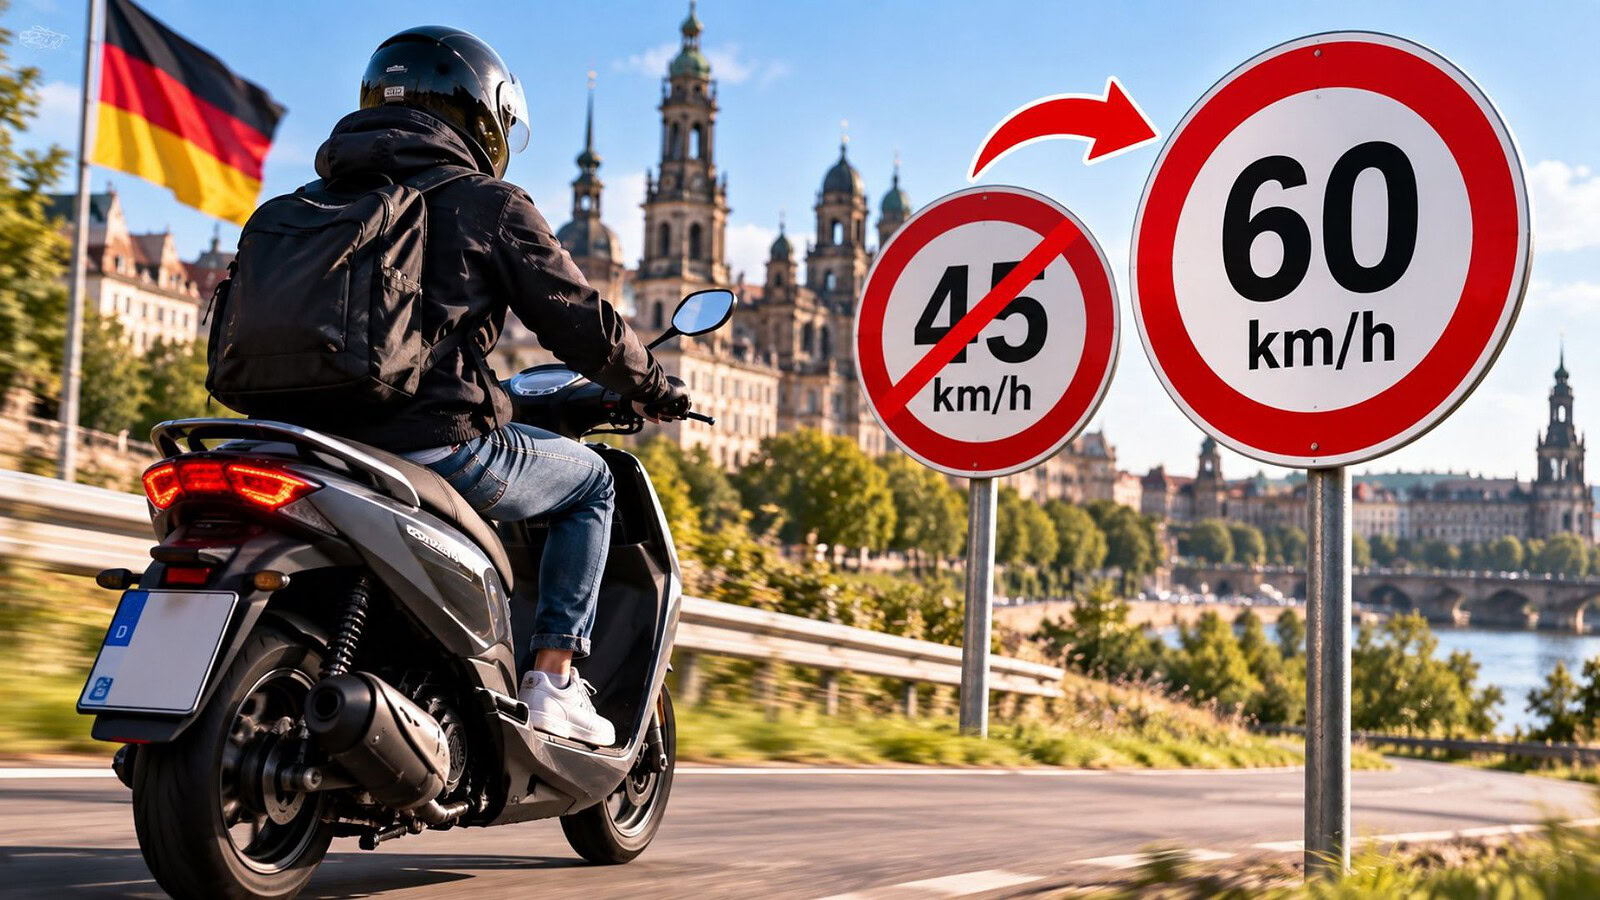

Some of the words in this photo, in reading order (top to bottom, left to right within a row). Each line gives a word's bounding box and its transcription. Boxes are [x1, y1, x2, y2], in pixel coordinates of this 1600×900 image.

[1222, 140, 1419, 303] 60
[914, 260, 1048, 364] 45
[1248, 310, 1395, 370] km/h
[933, 375, 1031, 415] km/h
[115, 625, 128, 639] D
